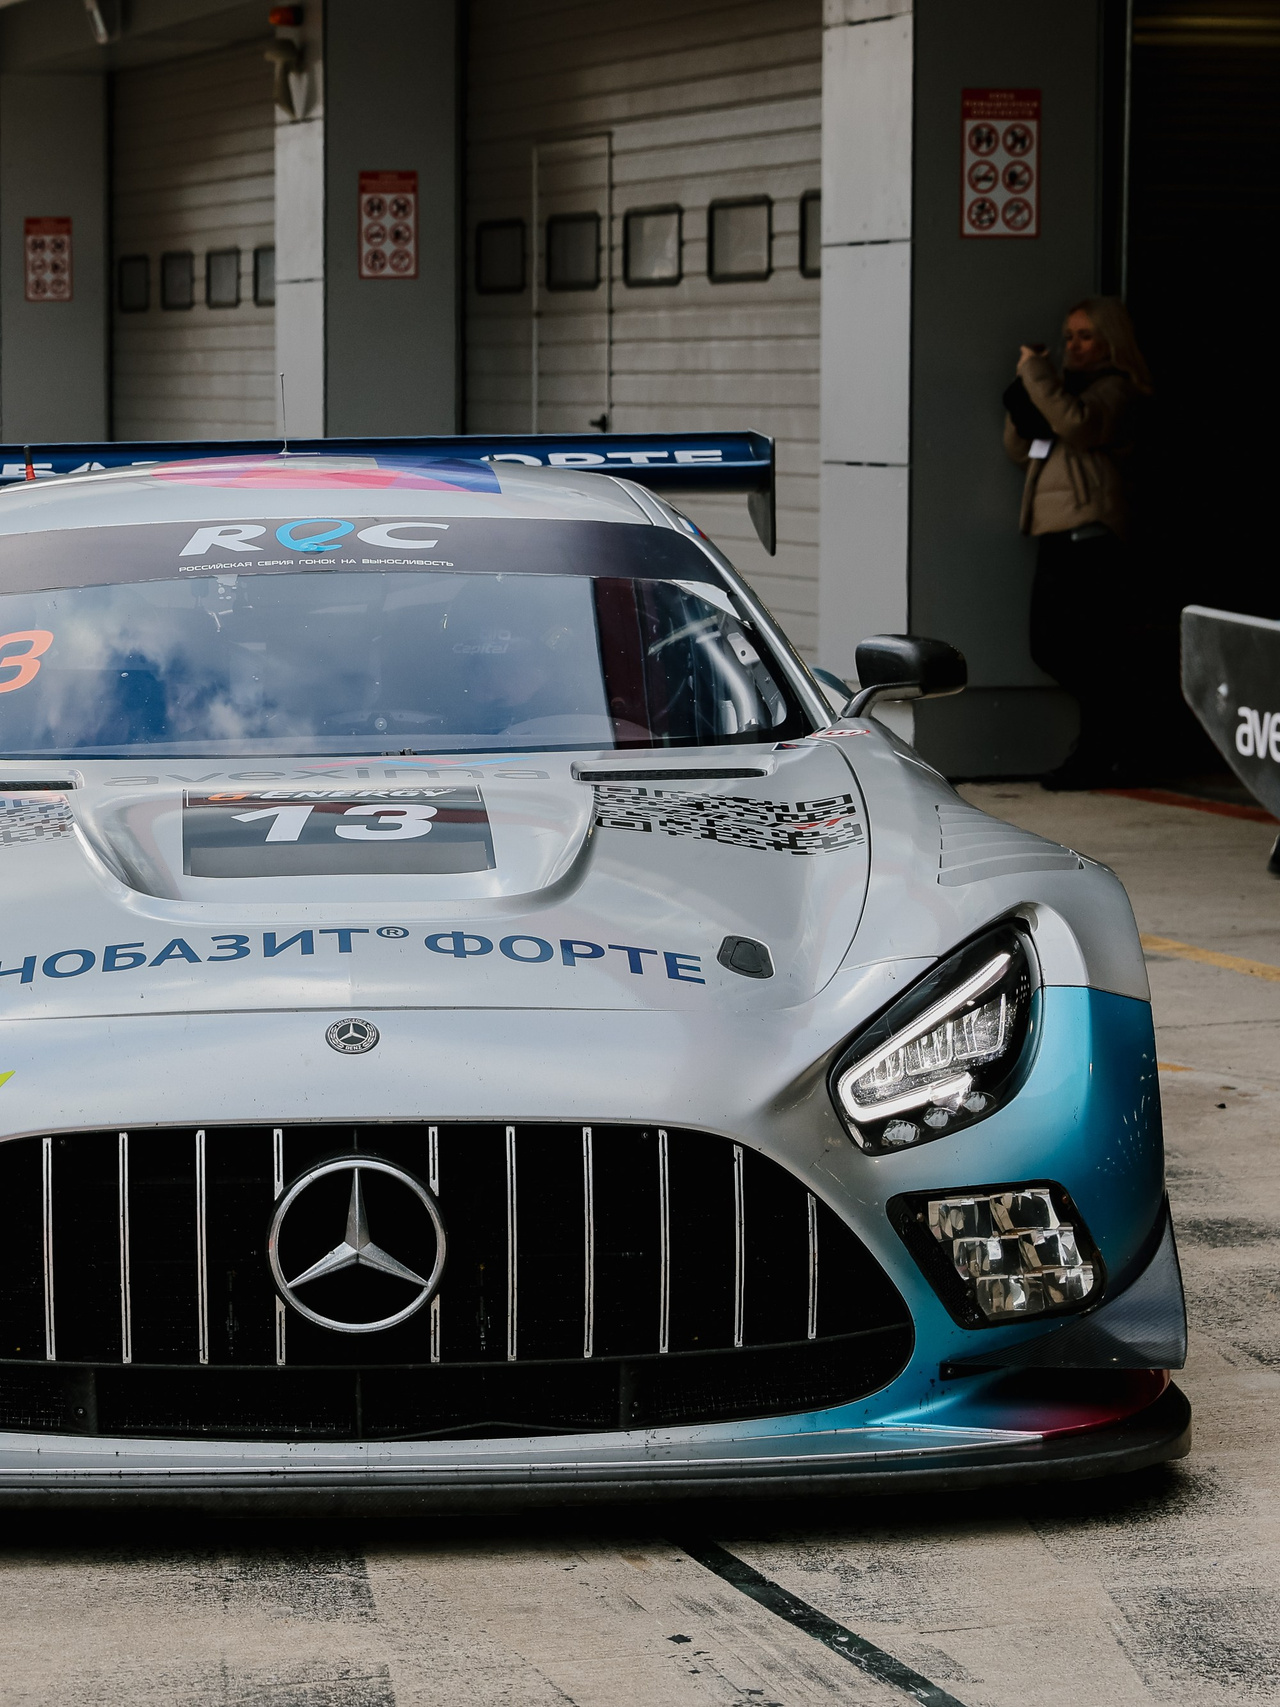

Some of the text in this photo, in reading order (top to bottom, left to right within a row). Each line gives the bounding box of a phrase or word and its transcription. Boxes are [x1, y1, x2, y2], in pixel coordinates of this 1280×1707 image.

[178, 561, 253, 573] РОССИЙСКАЯ
[257, 559, 294, 567] СЕРИЯ
[362, 558, 454, 567] ВЫНОСЛИВОСТЬ
[104, 766, 551, 787] avexima
[207, 787, 458, 801] G-ENERGY
[231, 804, 438, 842] 13
[423, 931, 707, 985] ФОРТЕ
